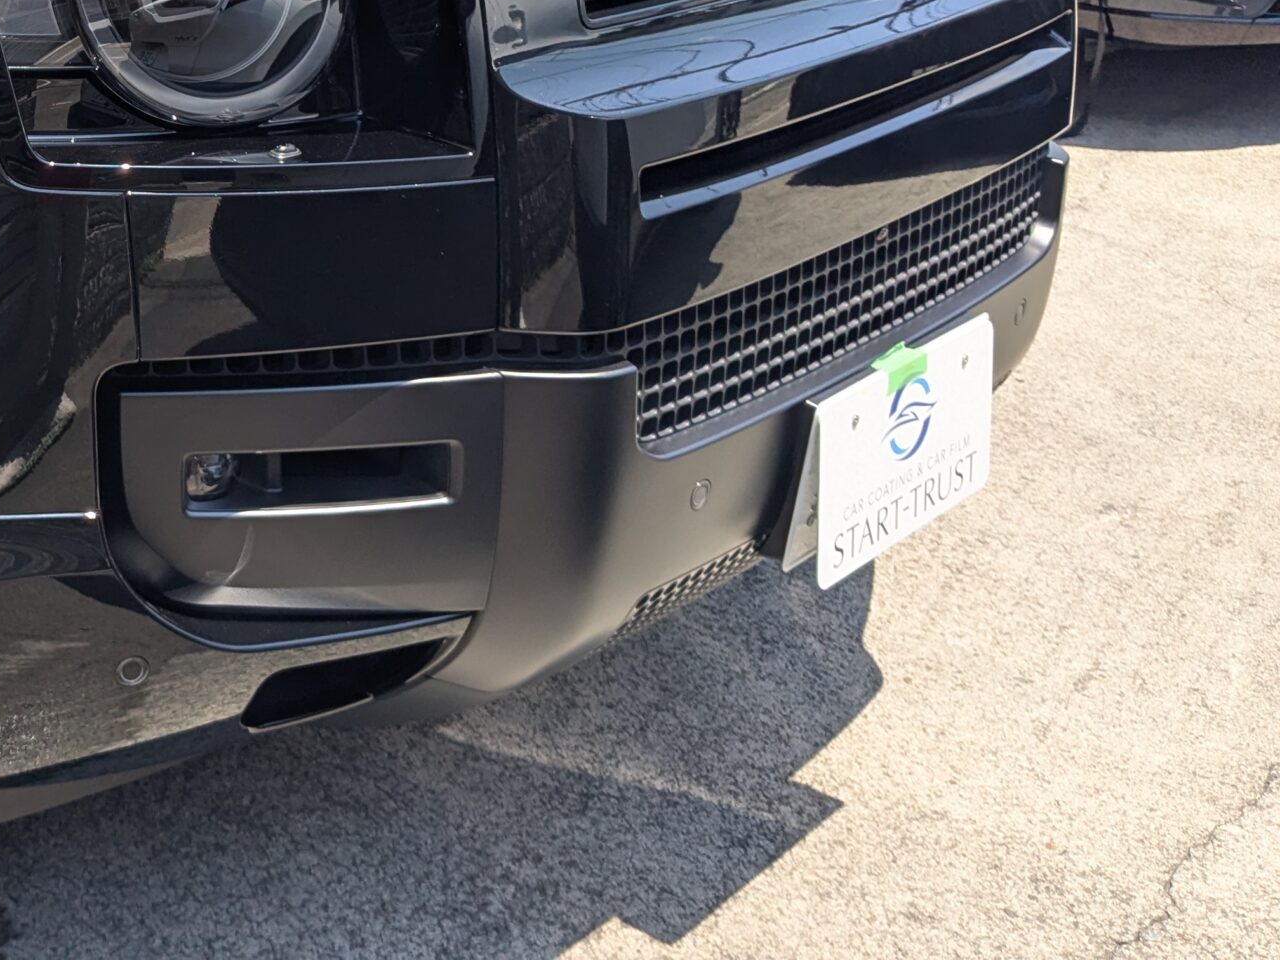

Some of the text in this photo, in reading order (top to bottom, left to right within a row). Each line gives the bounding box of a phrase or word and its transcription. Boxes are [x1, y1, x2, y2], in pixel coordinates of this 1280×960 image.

[832, 450, 978, 569] START-TRUST
[842, 433, 970, 522] CAR COATING & CAR FILM
